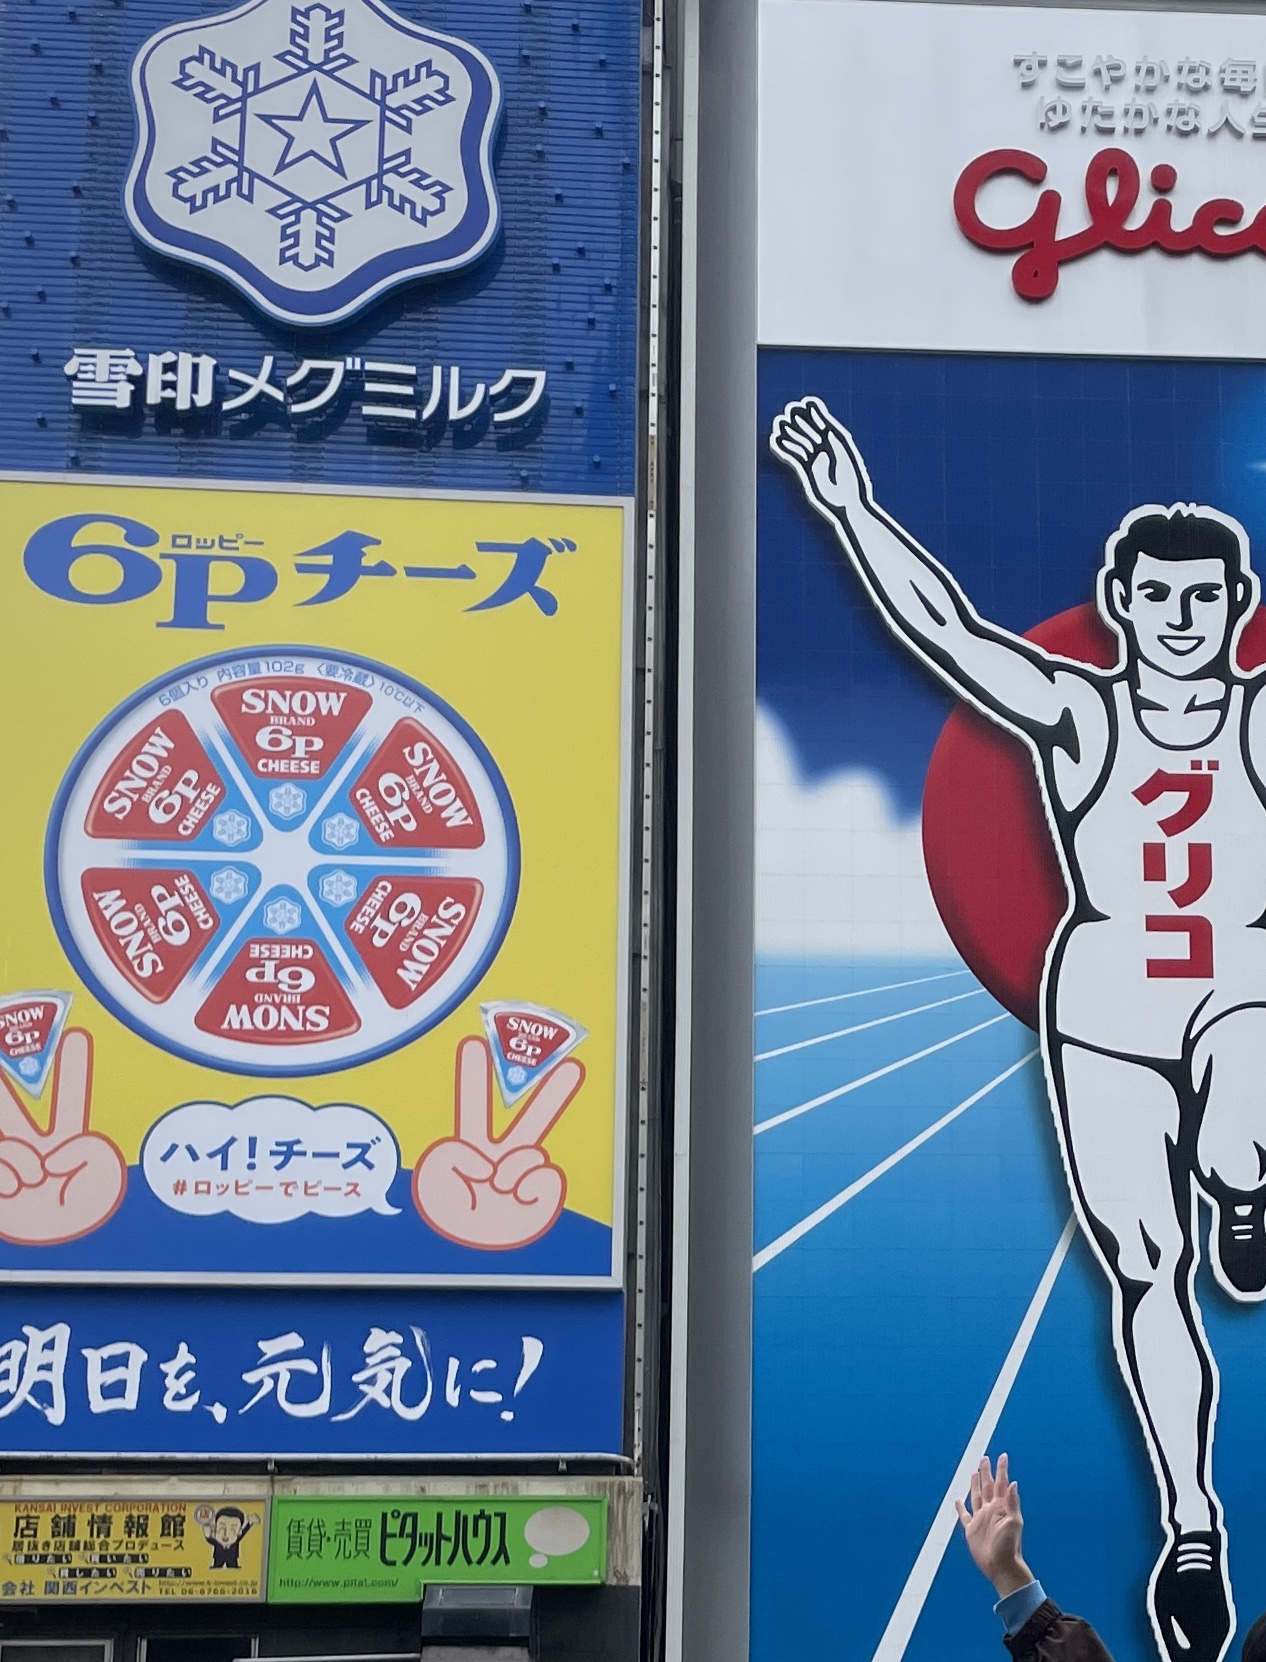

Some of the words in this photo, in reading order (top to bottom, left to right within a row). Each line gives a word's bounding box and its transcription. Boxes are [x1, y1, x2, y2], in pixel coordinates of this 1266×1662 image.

[63, 347, 547, 423] 雪印メグミルク
[171, 533, 265, 551] ロッピー
[241, 688, 347, 718] SNOW
[269, 716, 316, 727] BRAND
[102, 727, 176, 821] SNOW
[142, 764, 173, 805] BRAND
[257, 758, 321, 775] CHEESE
[402, 741, 474, 830] SNOW
[178, 782, 222, 837] CHEESE
[406, 774, 433, 814] BRAND
[355, 787, 395, 844] CHEESE
[1131, 759, 1220, 979] グリコ
[173, 873, 215, 932] CHEESE
[349, 879, 393, 936] CHEESE
[93, 888, 165, 979] SNOW
[135, 903, 160, 945] BRAND
[396, 896, 467, 991] SNOW
[399, 913, 428, 953] BRAND
[249, 942, 314, 959] CHEESE
[220, 1004, 331, 1032] SNOW
[254, 992, 302, 1004] BRAND
[506, 1016, 558, 1040] SNOW
[13, 1513, 187, 1539] 店舗情報館
[14, 1503, 57, 1513] KANSAI
[60, 1503, 100, 1513] INVEST
[105, 1502, 187, 1513] CORPORATION
[285, 1518, 372, 1560] 賃貸・売買
[379, 1508, 511, 1567] ピタットハウス
